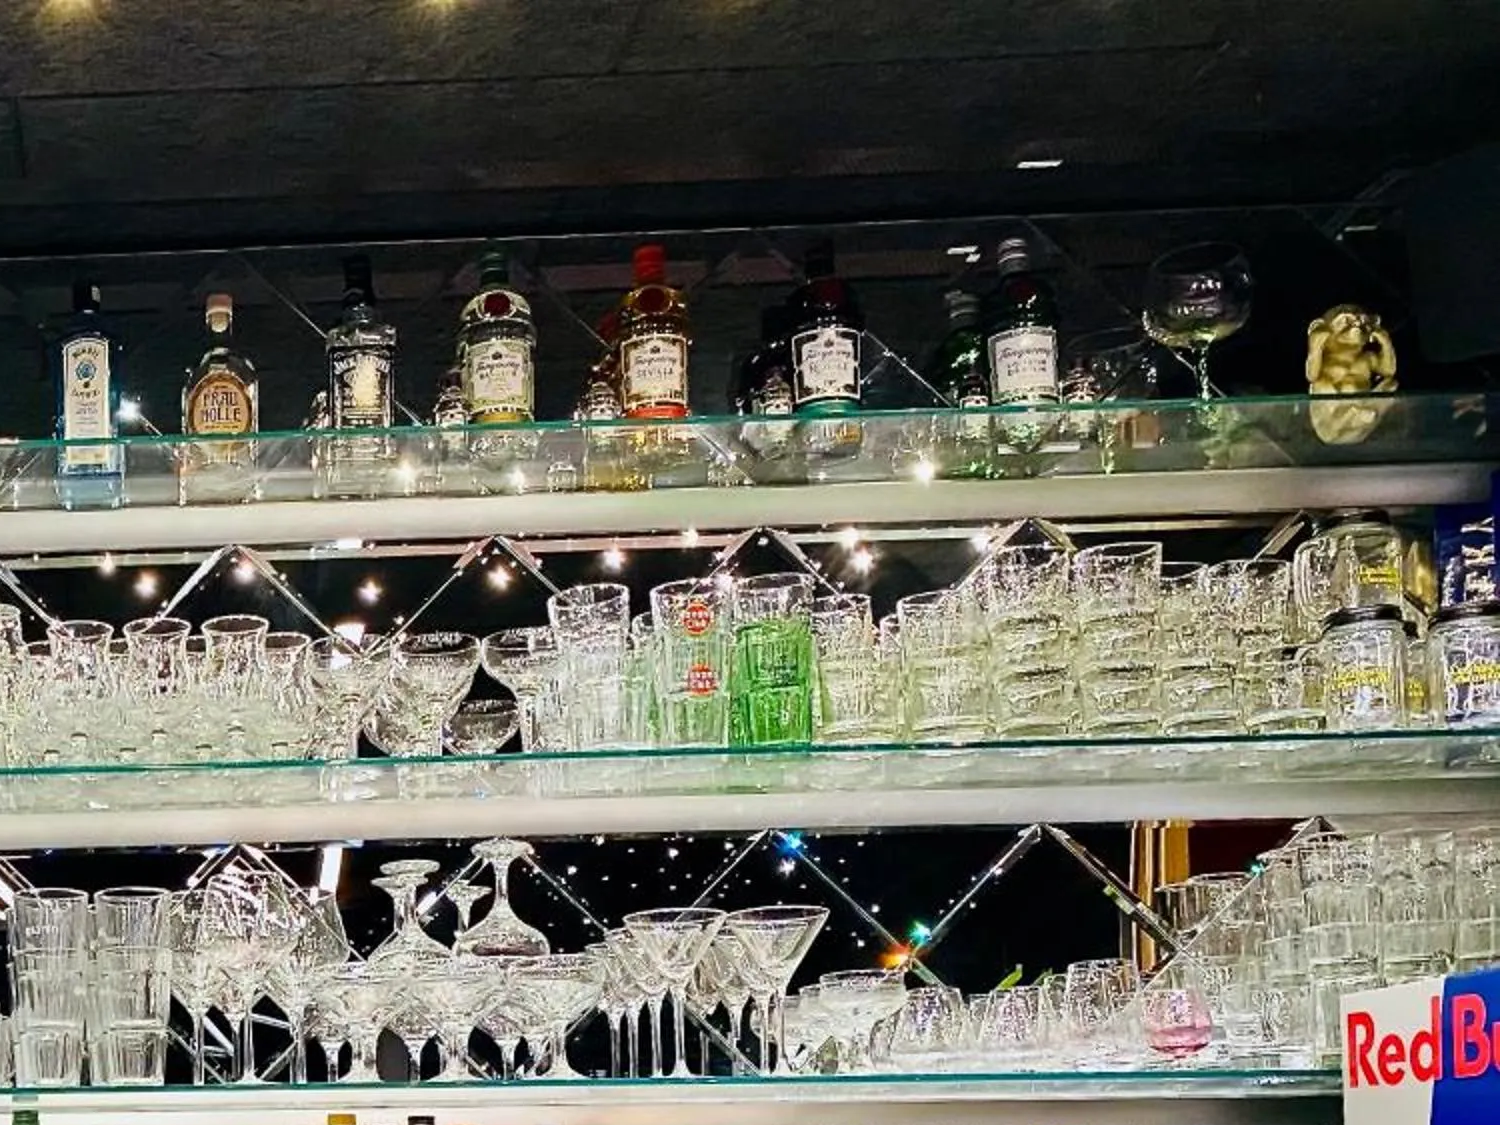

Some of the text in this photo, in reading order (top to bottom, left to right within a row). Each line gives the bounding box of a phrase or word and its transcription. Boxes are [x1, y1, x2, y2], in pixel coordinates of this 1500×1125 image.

[202, 391, 238, 408] FRAU
[201, 407, 241, 423] HOLLE
[1347, 996, 1442, 1089] Red
